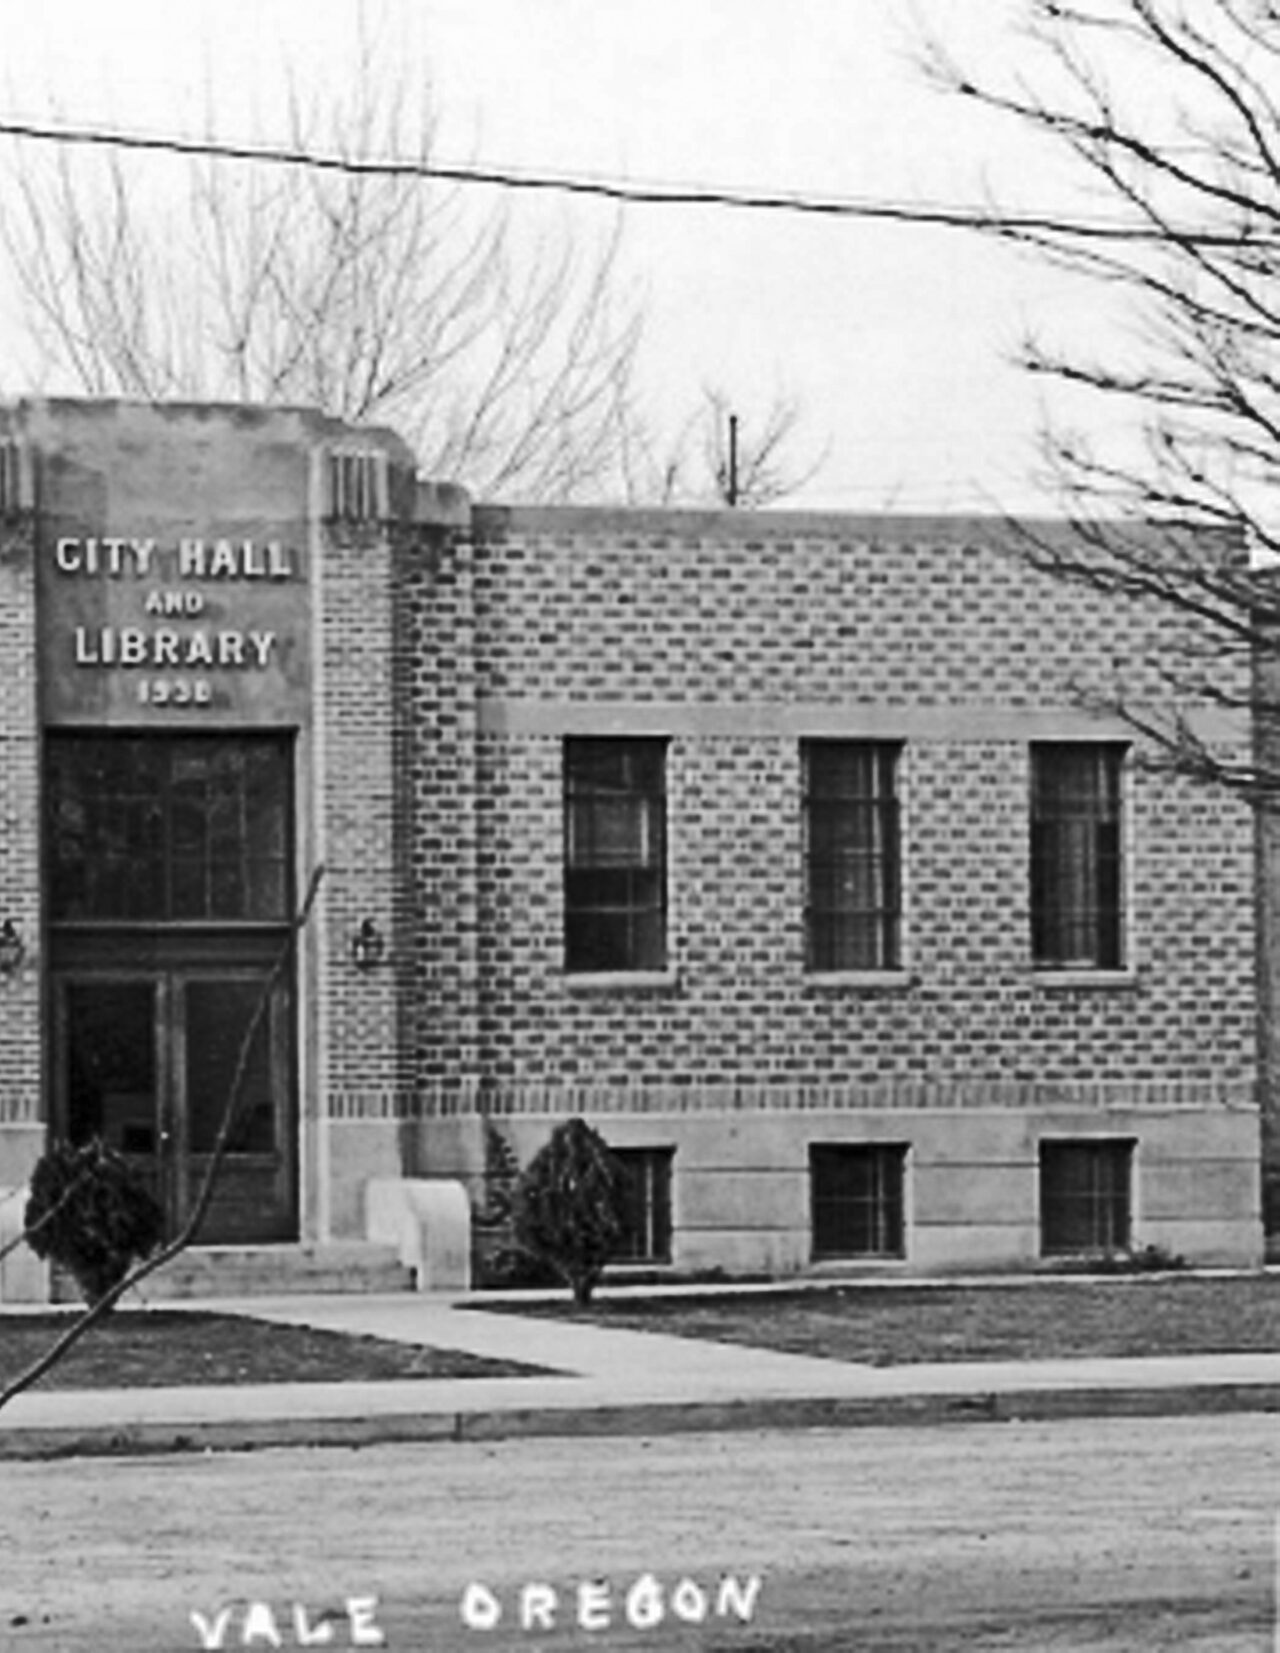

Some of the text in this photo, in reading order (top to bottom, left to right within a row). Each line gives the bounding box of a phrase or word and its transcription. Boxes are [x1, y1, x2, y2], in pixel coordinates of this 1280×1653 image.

[56, 537, 292, 575] CITY HALL
[145, 590, 204, 614] AND
[76, 626, 276, 665] LIBRARY
